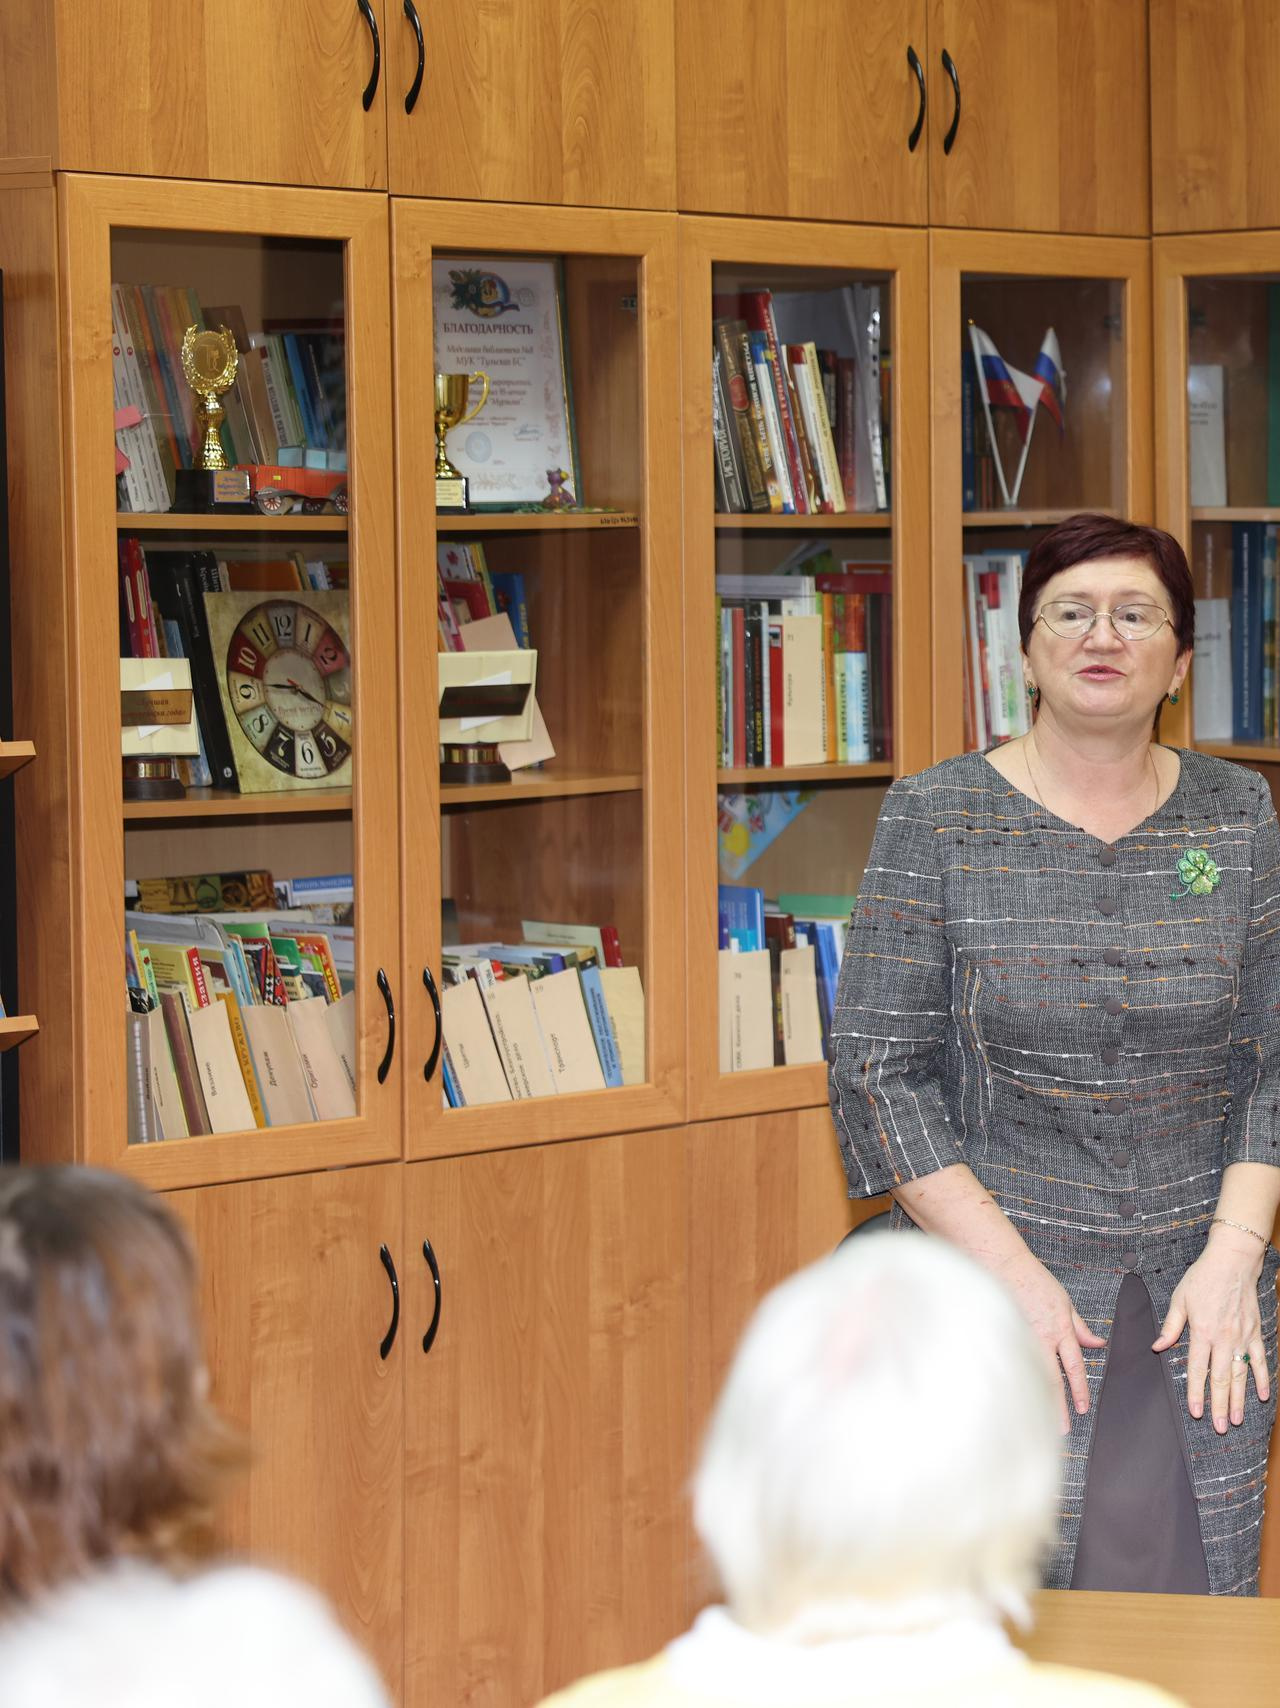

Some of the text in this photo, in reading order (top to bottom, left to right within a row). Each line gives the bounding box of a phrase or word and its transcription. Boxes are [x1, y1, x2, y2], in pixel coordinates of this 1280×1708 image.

[443, 323, 534, 336] БЛАГОДАРНОСТЬ
[252, 623, 270, 646] 11
[275, 615, 291, 637] 12
[304, 623, 312, 643] 1
[238, 647, 258, 672] 10
[320, 647, 337, 665] 2
[239, 684, 256, 700] 9
[253, 713, 269, 733] 8
[276, 732, 291, 758] 7
[301, 741, 314, 765] 6
[320, 731, 337, 757] 5
[549, 1032, 566, 1073] Транспорт
[204, 1060, 218, 1097] Вязание
